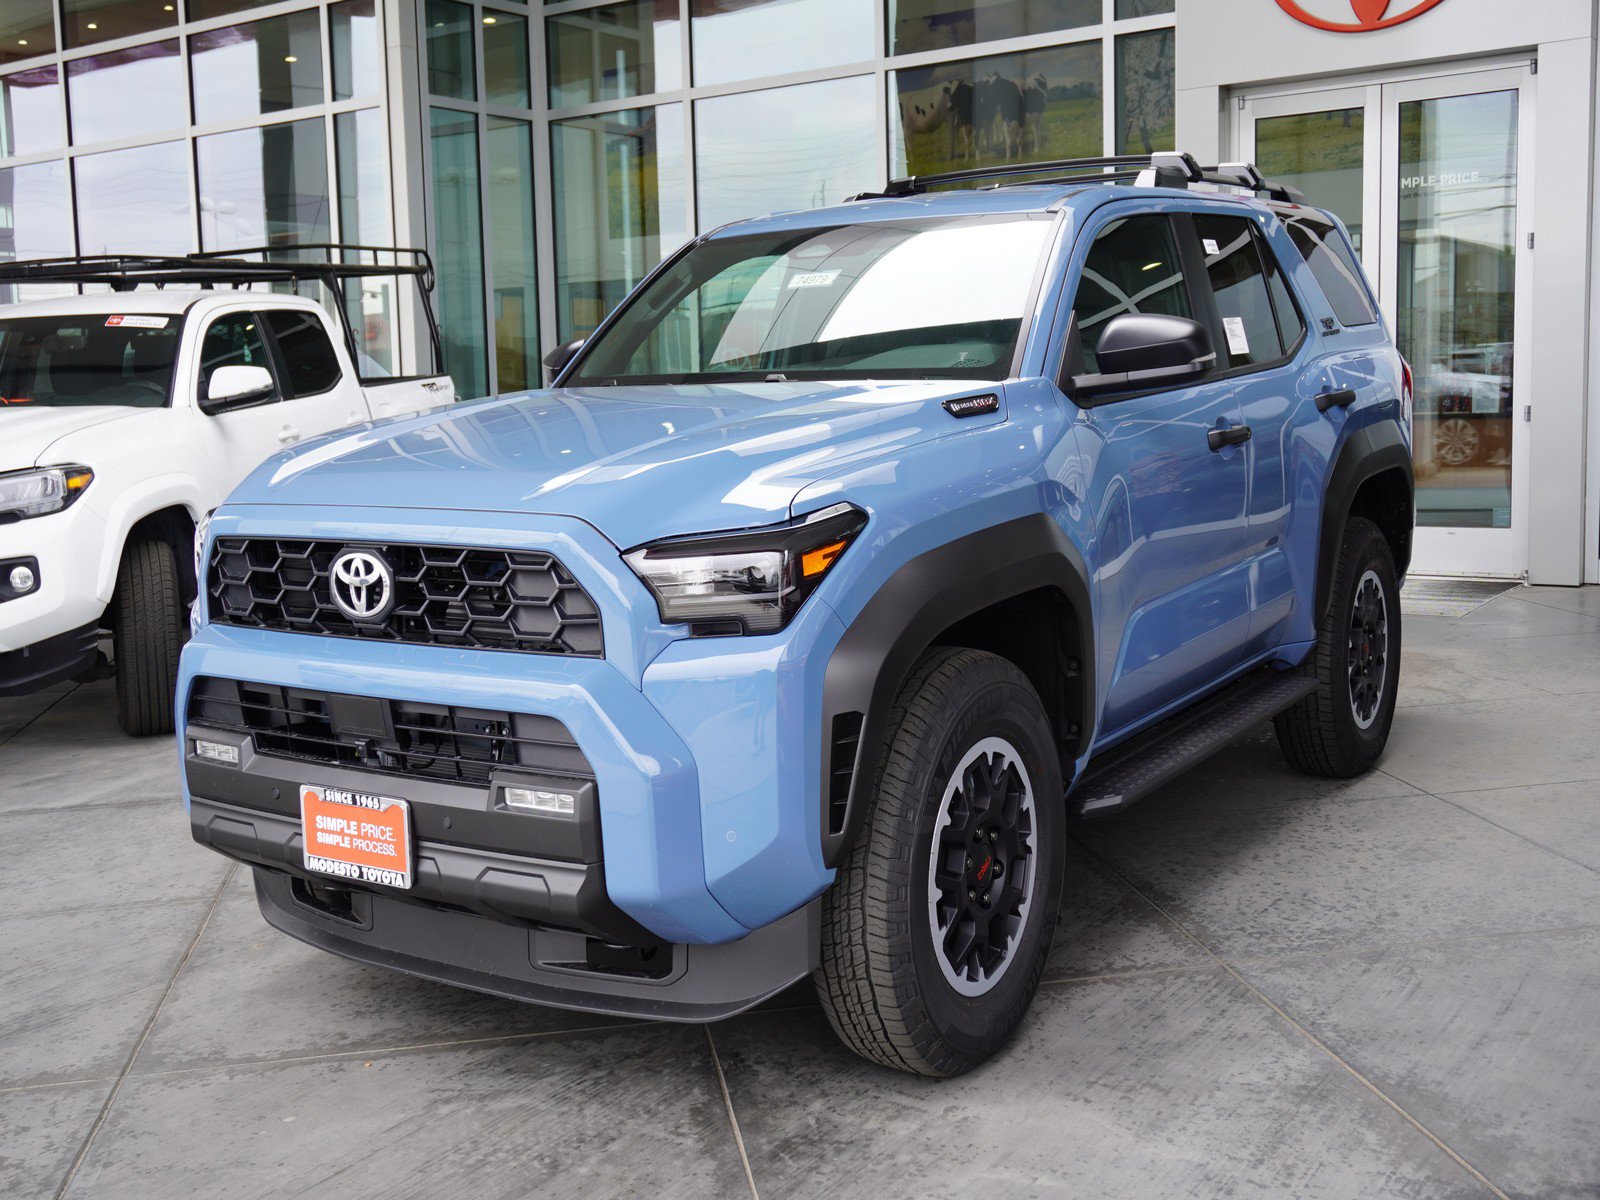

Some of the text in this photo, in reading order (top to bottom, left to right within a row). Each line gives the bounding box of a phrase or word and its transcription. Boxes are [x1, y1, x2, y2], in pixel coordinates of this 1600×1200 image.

[1440, 171, 1479, 185] PRICE
[796, 274, 829, 285] 74979
[325, 790, 379, 809] SINCE 1965
[316, 815, 397, 842] SIMPLE PRICE.
[316, 832, 398, 857] SIMPLE PROCESS.
[309, 857, 405, 887] MODESTO TOYOTA
